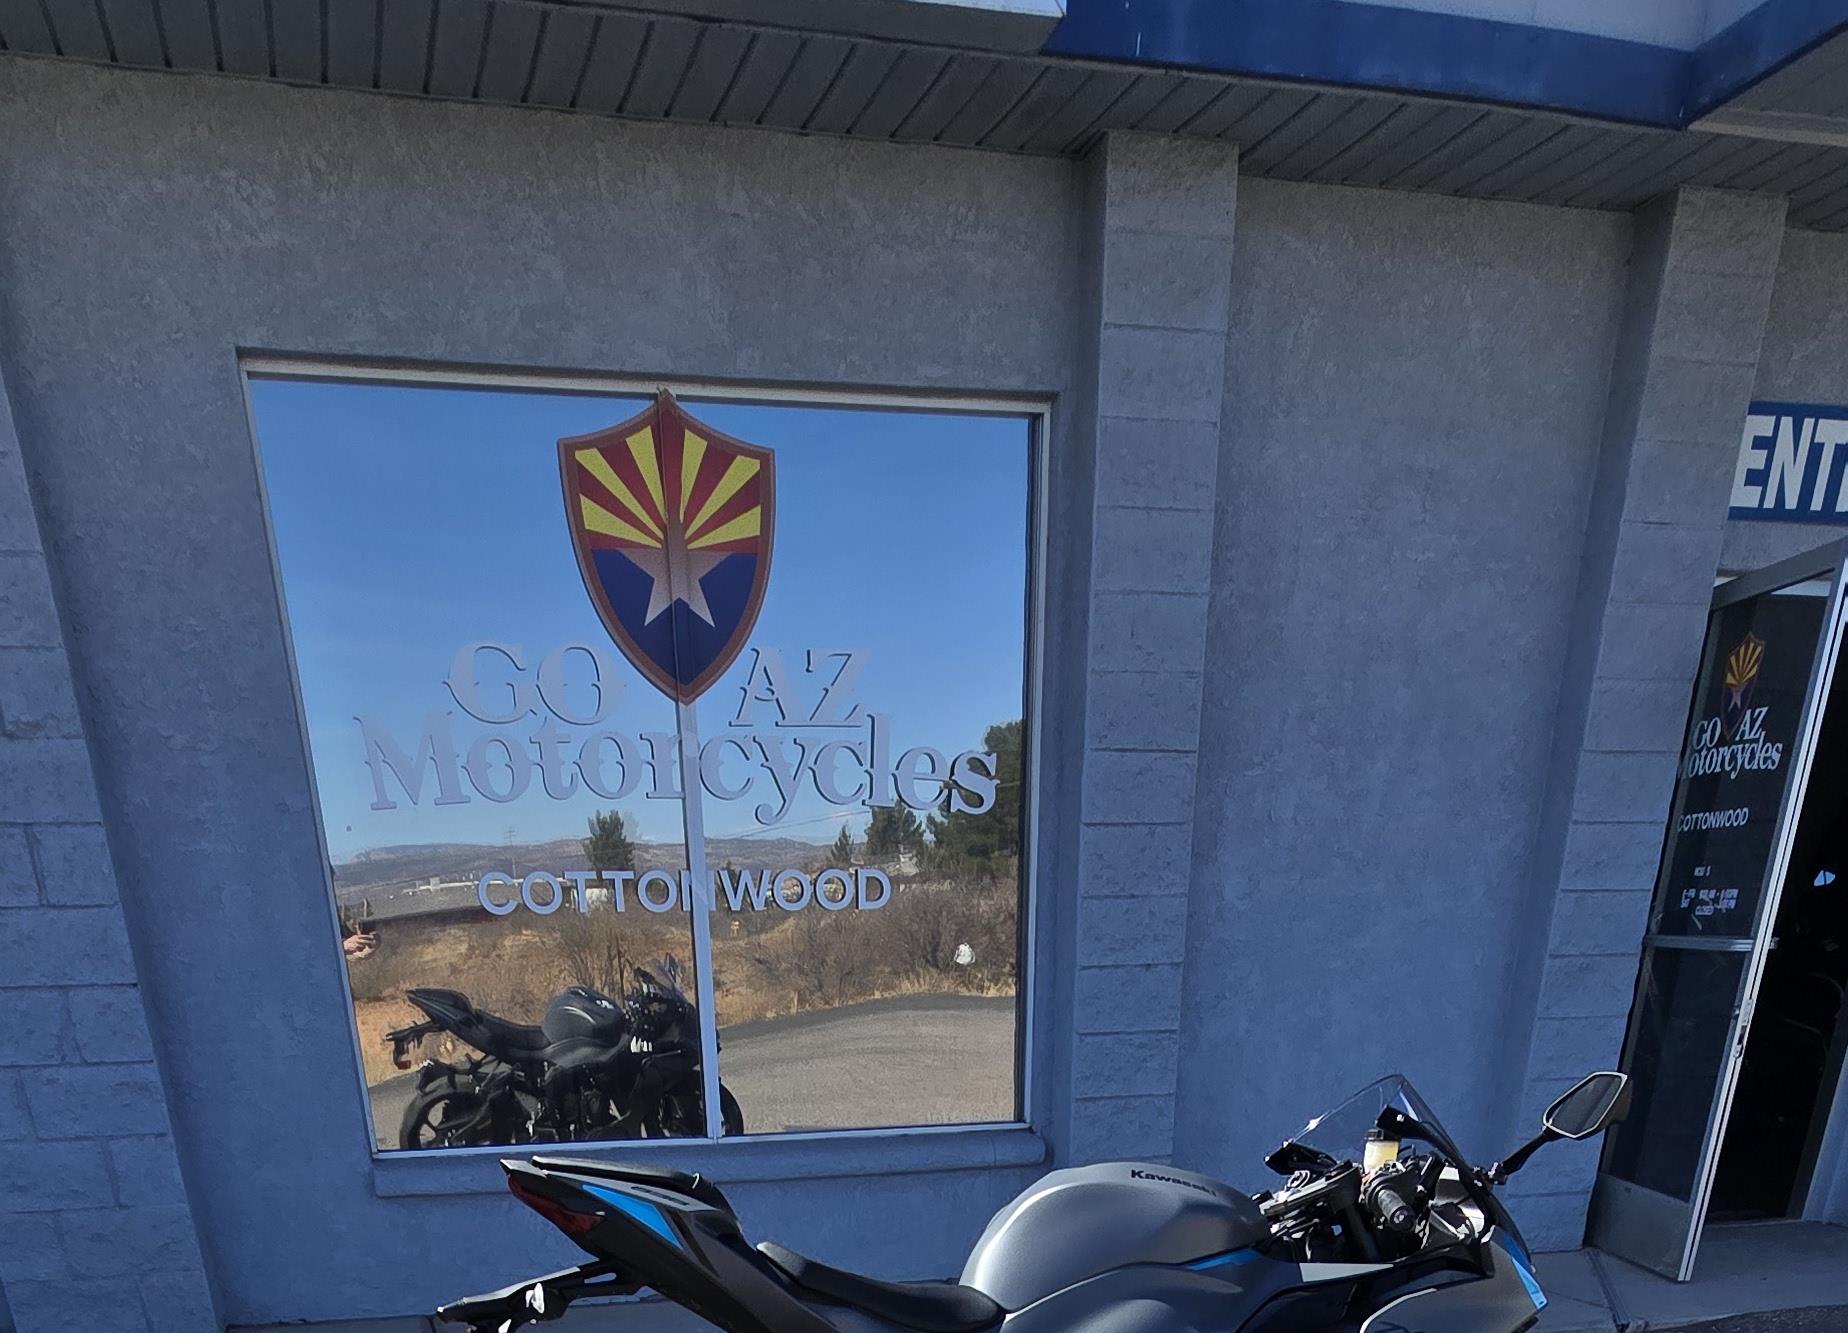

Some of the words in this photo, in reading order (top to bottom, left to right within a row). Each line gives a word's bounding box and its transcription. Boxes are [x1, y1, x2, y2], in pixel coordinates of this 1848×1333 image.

[1728, 414, 1848, 513] ENT
[441, 640, 624, 726] GO
[728, 646, 870, 728] AZ
[1693, 716, 1722, 750] GO
[1735, 706, 1769, 741] AZ
[352, 712, 1001, 826] Motorcycles
[1679, 731, 1783, 780] otorcycles
[1677, 807, 1749, 833] COTTONWOOD
[477, 868, 892, 915] COTTONWOOD
[1130, 1169, 1217, 1197] Kawasaki
